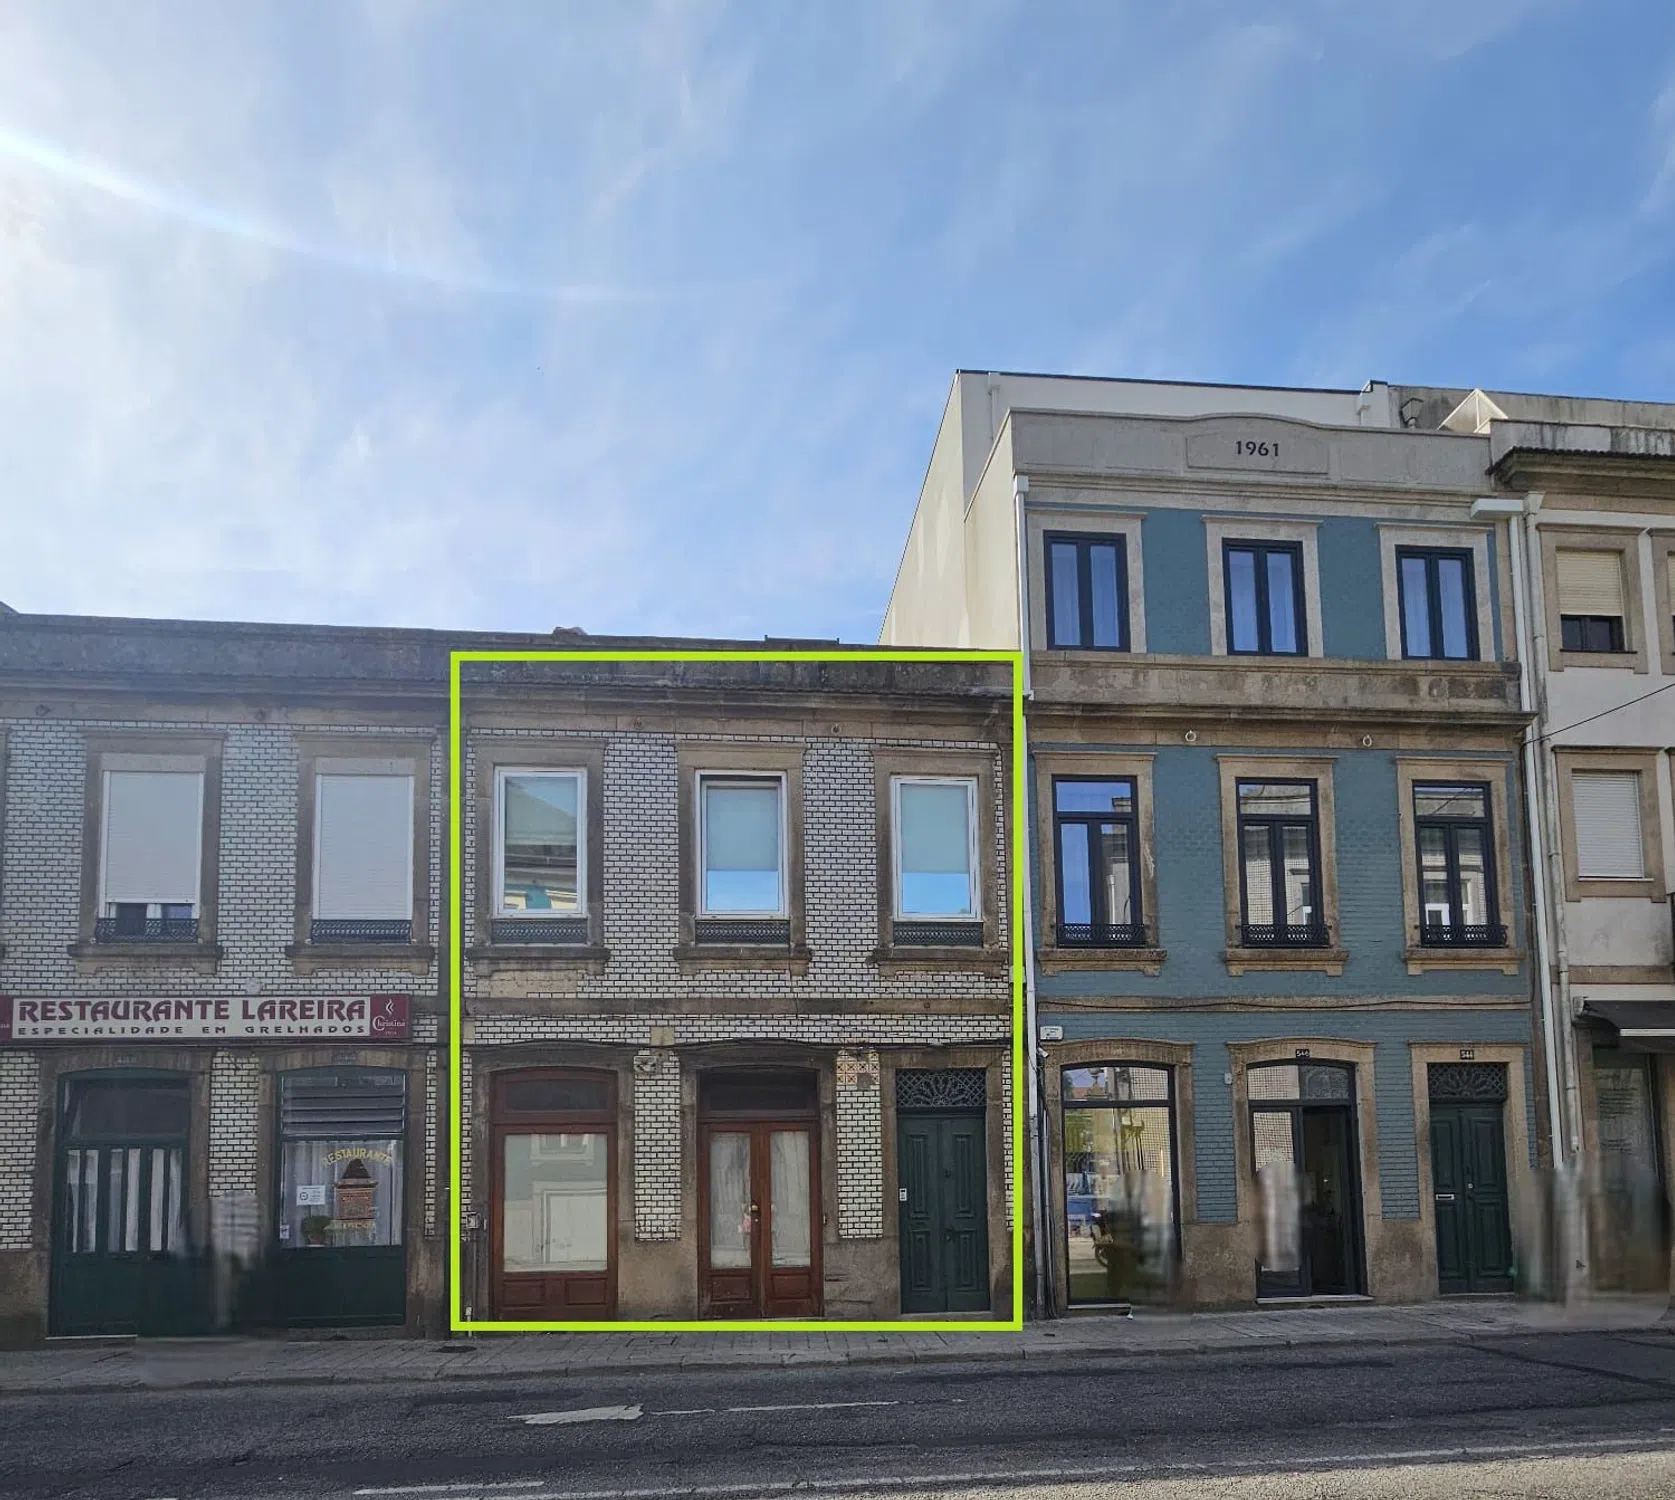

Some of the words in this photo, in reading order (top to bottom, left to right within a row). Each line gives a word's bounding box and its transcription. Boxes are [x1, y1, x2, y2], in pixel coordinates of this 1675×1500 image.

[1236, 440, 1279, 457] 1961
[18, 1000, 230, 1023] RESTAURANTE
[241, 999, 366, 1022] LAREIRA
[18, 1026, 184, 1035] ESPECIALIDADE
[202, 1026, 226, 1034] EM
[244, 1025, 365, 1034] GRELHADOS
[322, 1147, 393, 1168] RESTAURANTE
